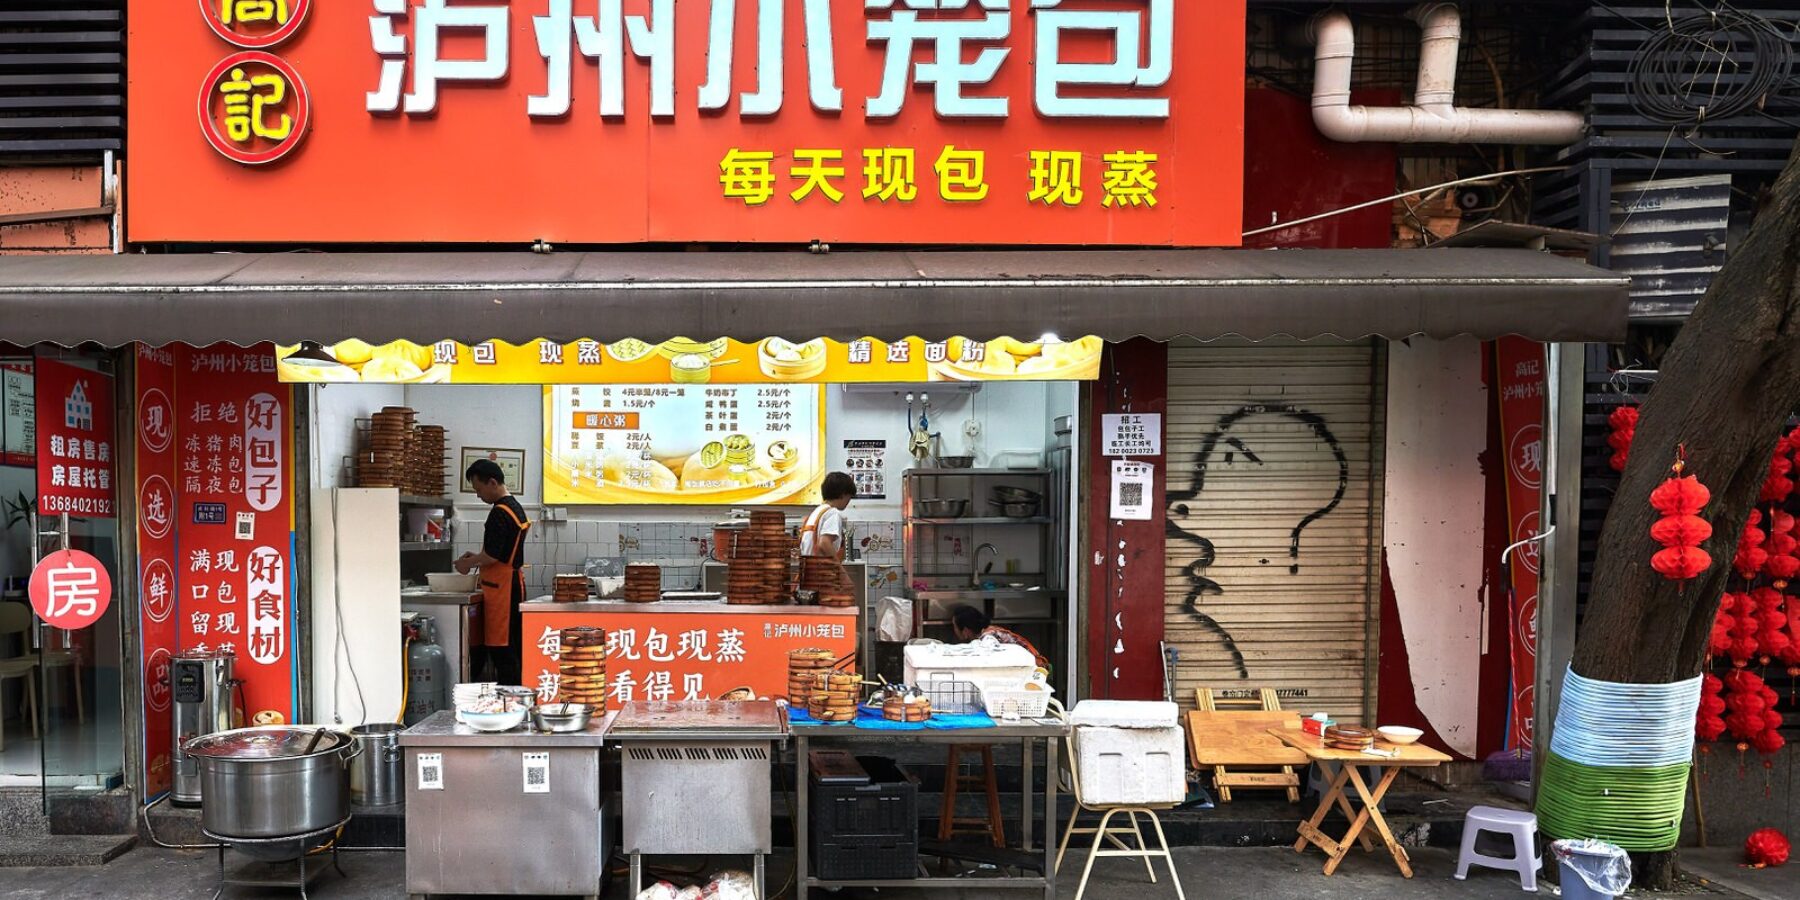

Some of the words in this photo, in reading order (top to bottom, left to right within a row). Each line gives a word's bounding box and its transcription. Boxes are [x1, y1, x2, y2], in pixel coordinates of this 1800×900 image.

[366, 0, 1174, 119] 泸州小笼包
[719, 144, 989, 206] 每天现包
[1028, 150, 1159, 209] 现蒸
[433, 341, 497, 364] 现包
[539, 341, 602, 364] 现蒸
[847, 341, 986, 364] 精选面粉
[191, 353, 276, 373] 泸州小笼包
[757, 388, 791, 397] 2.5元/个
[190, 401, 238, 423] 拒绝
[623, 400, 656, 408] 1.5元/个
[757, 400, 791, 408] 2.5元/个
[586, 414, 626, 427] 暖心粥
[705, 411, 738, 420] 茶叶蛋
[766, 411, 792, 420] 2元/个
[1121, 415, 1142, 424] 招工
[626, 432, 652, 441] 2元/人
[766, 423, 792, 432] 2元/个
[50, 433, 110, 463] 租房售房
[185, 433, 243, 453] 冻猪肉
[247, 400, 279, 505] 好包子
[626, 442, 652, 450] 2元/人
[184, 454, 243, 473] 速冻包
[51, 464, 109, 489] 房屋托管
[185, 475, 244, 495] 隔夜包
[46, 562, 99, 617] 房
[250, 552, 282, 658] 好食材
[774, 623, 845, 639] 泸州小笼包
[537, 625, 747, 662] 每现包现蒸
[537, 669, 710, 704] 新看得见
